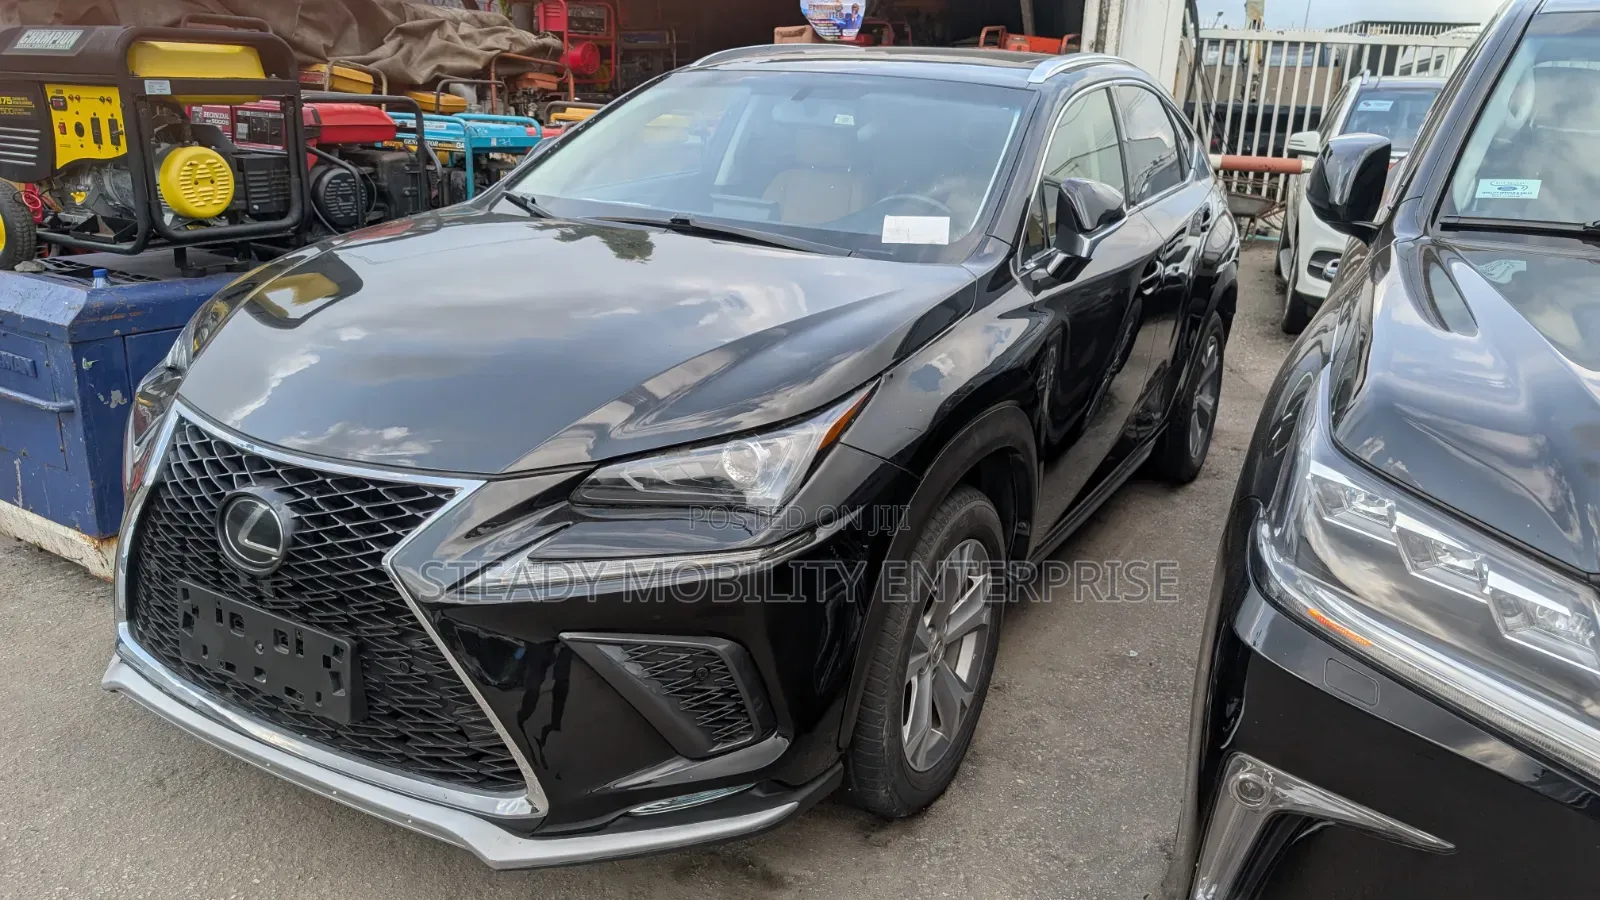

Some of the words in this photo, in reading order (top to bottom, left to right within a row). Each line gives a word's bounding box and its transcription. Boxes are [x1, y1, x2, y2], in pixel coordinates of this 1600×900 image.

[20, 30, 83, 44] CHAMPION
[203, 111, 230, 120] HONDA
[404, 138, 439, 147] GENTOR
